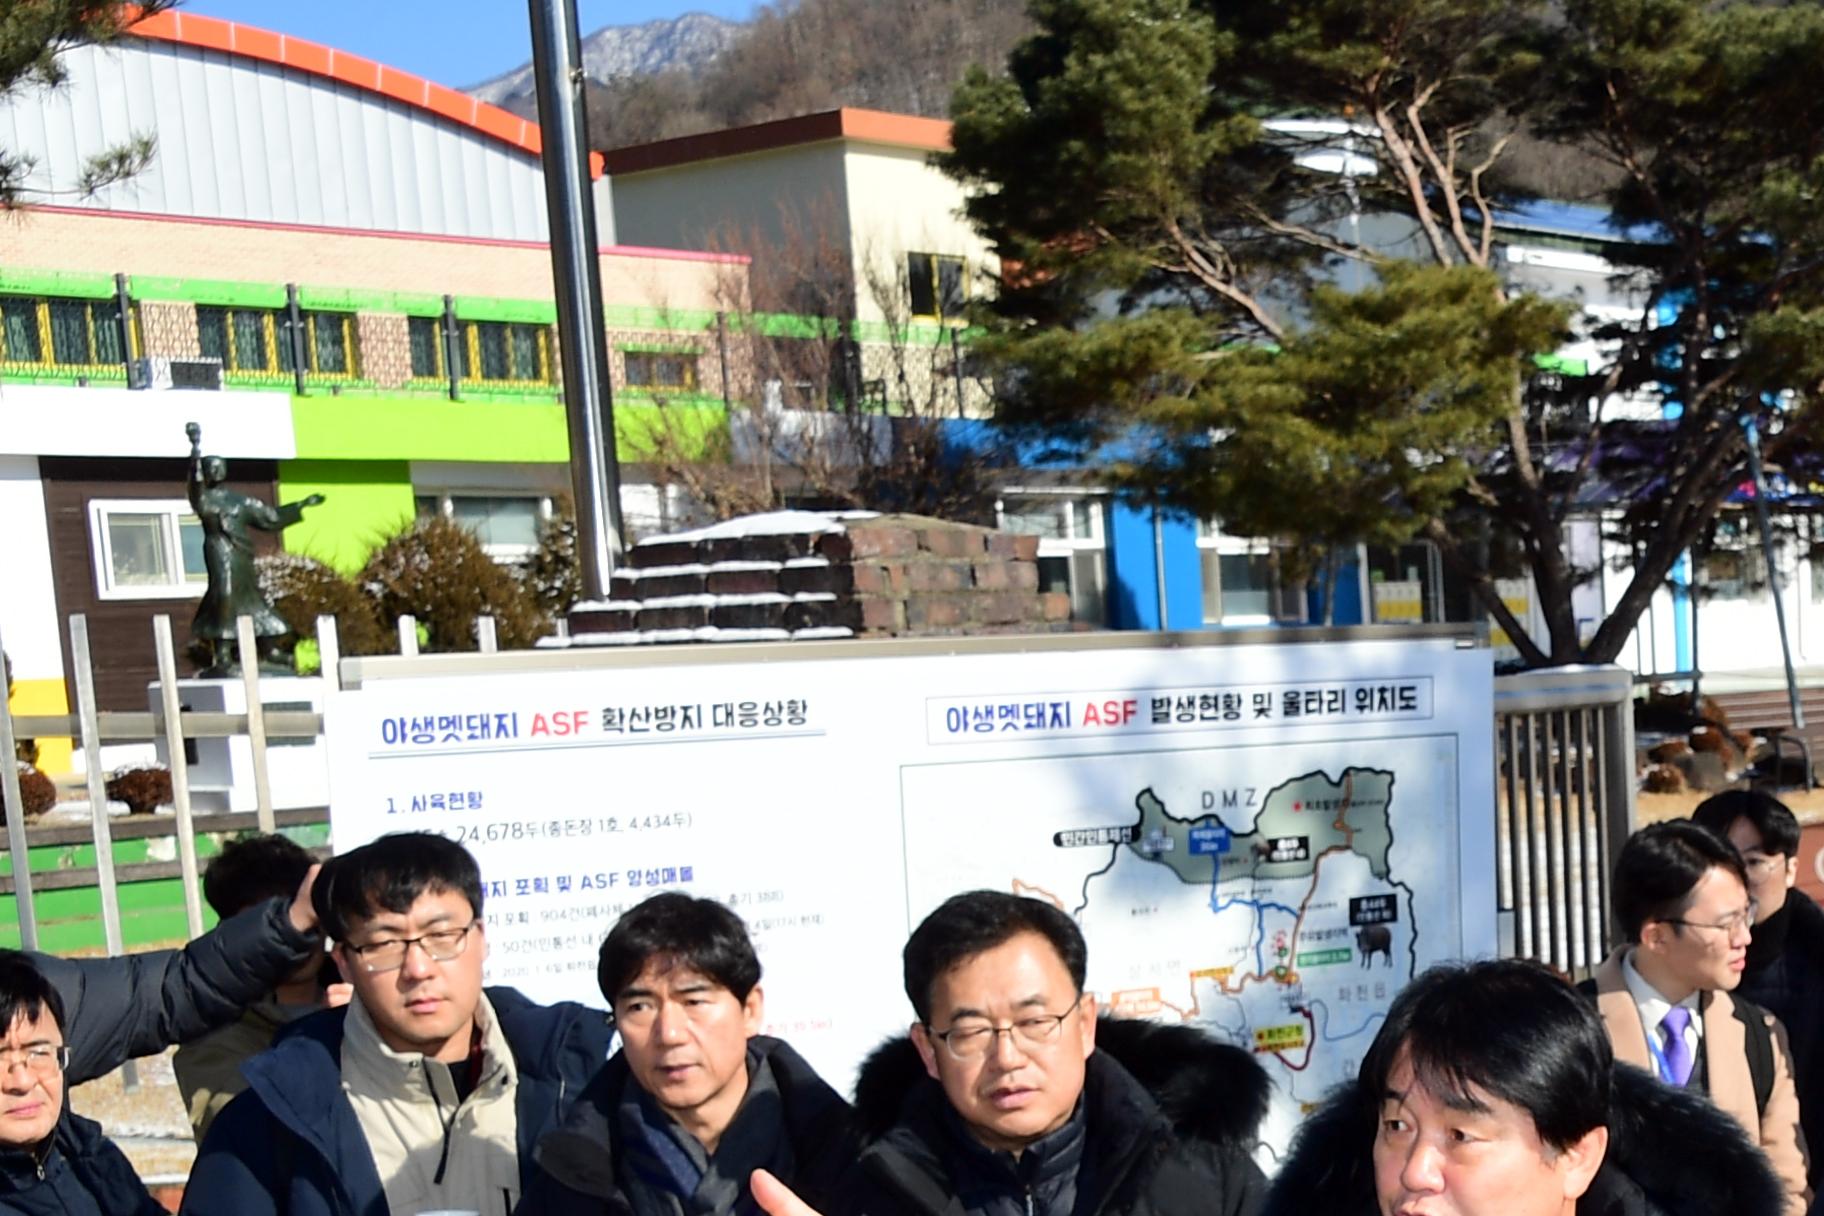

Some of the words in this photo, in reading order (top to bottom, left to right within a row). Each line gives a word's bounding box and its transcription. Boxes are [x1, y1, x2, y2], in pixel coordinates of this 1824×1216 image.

[382, 712, 518, 744] 야생멧돼지
[530, 711, 589, 737] ASF
[602, 704, 702, 733] 확산방지
[712, 699, 807, 728] 대응상황
[946, 701, 1071, 733] 야생멧돼지
[1083, 700, 1137, 727] ASF
[1151, 692, 1242, 724] 발생현황
[1253, 692, 1272, 719] 및
[1283, 689, 1347, 717] 울타리
[1355, 686, 1418, 712] 위치도
[411, 791, 483, 813] 사육현황
[581, 872, 620, 890] ASF
